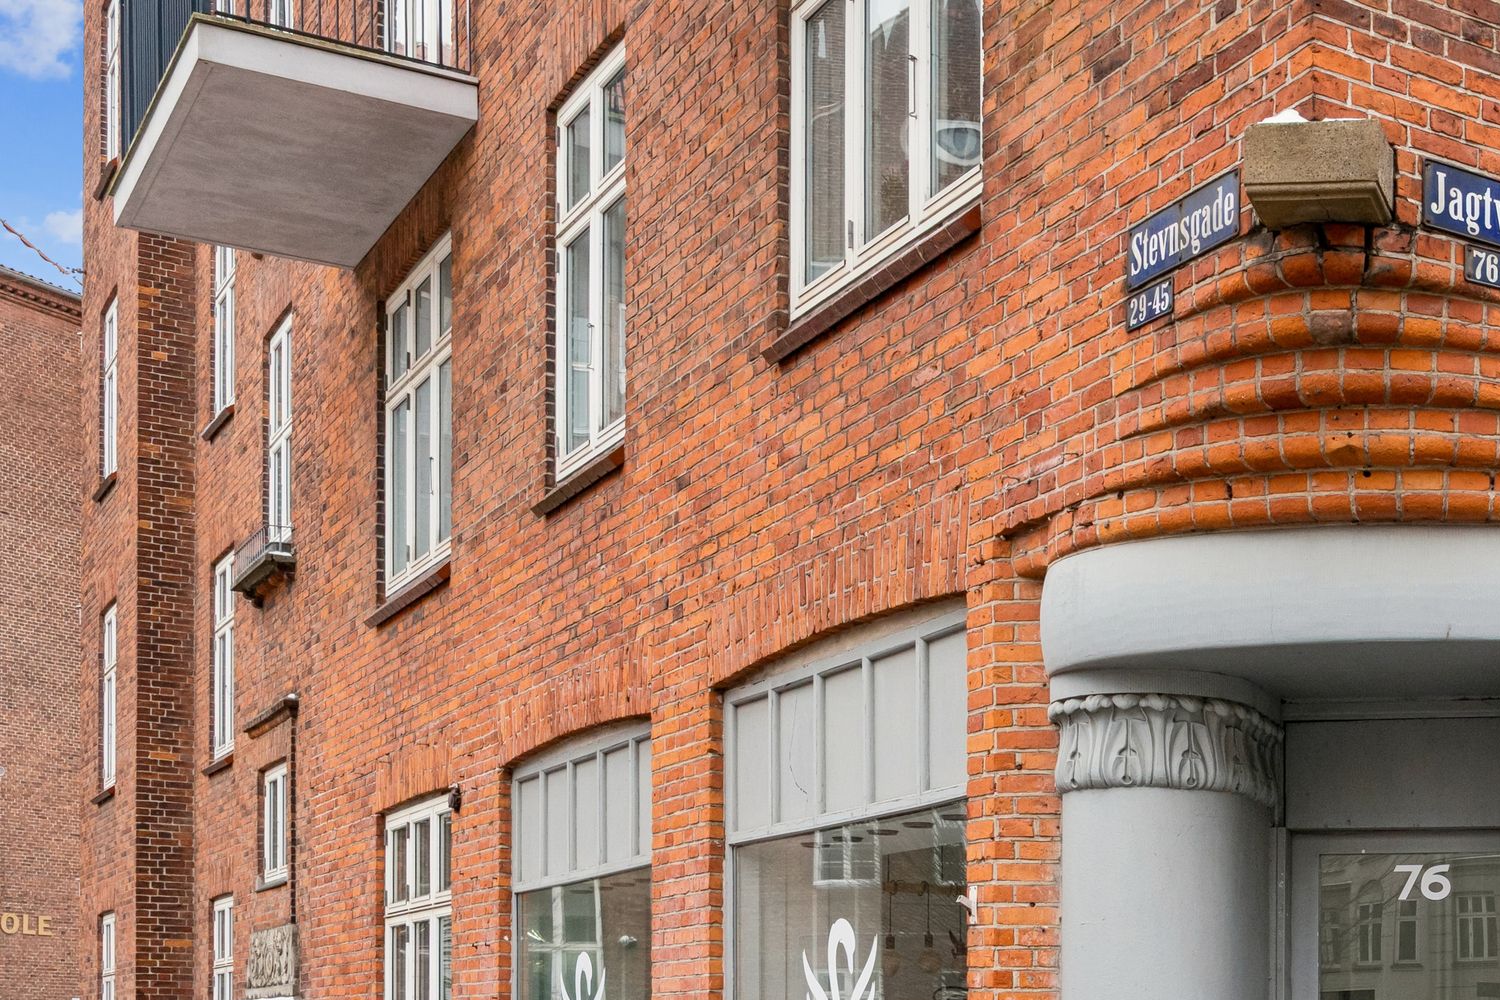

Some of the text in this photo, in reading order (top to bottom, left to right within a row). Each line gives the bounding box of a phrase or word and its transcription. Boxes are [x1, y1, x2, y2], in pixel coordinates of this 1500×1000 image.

[1129, 186, 1236, 276] Stevnsgade
[1128, 281, 1171, 328] 29-45
[1393, 864, 1452, 901] 76
